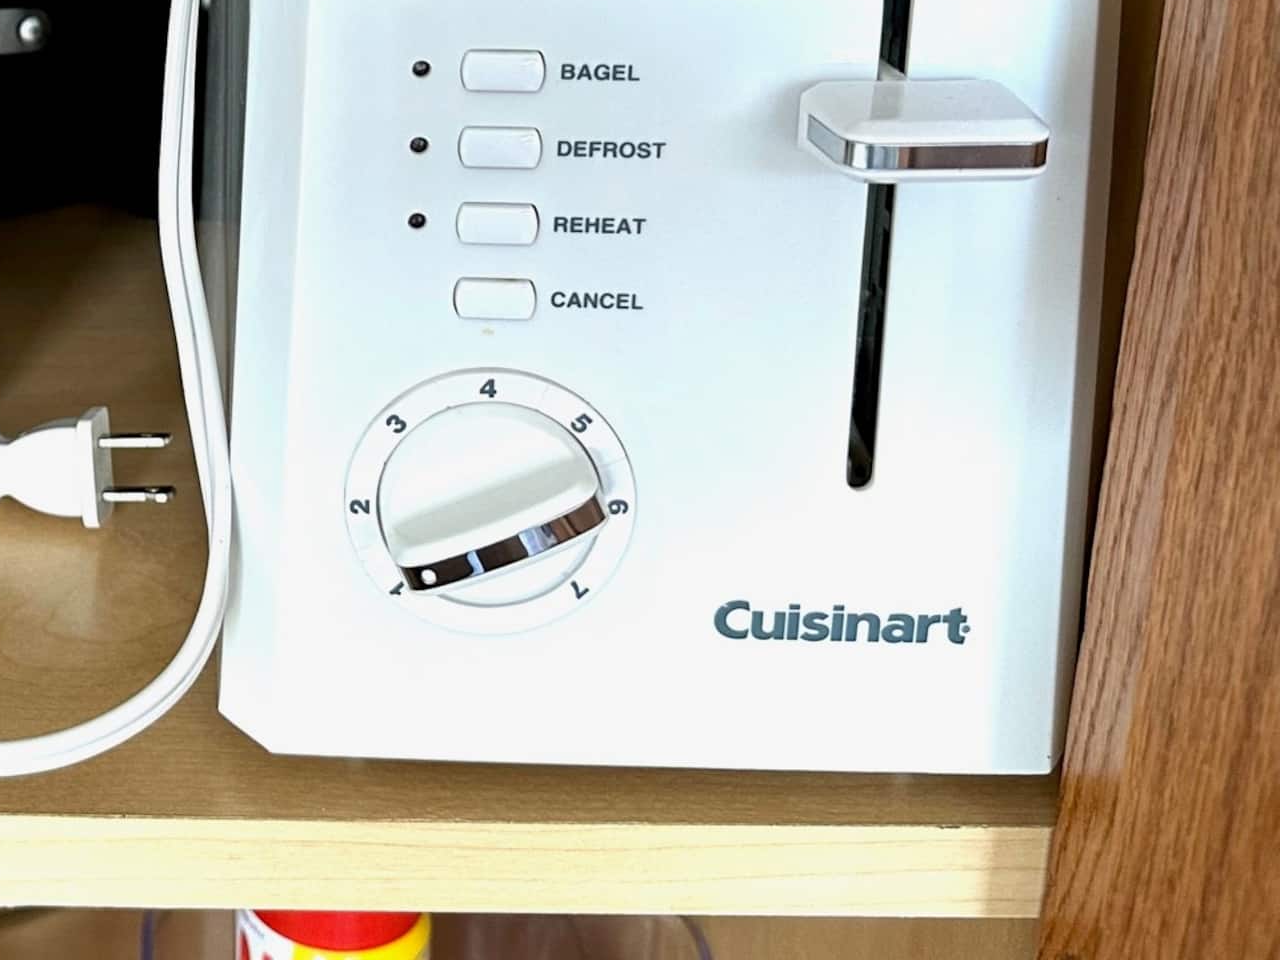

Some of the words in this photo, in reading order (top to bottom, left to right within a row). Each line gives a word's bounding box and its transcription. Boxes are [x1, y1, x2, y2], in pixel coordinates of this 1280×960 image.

[560, 63, 640, 82] BAGEL
[556, 141, 667, 159] DEFROST
[553, 216, 647, 235] REHEAT
[550, 291, 644, 310] CANCEL
[479, 378, 497, 398] 4
[385, 414, 408, 434] 3
[571, 413, 593, 434] 5
[349, 499, 370, 515] 2
[608, 498, 629, 515] 6
[570, 580, 589, 599] 7
[713, 599, 969, 645] Cuisinart
